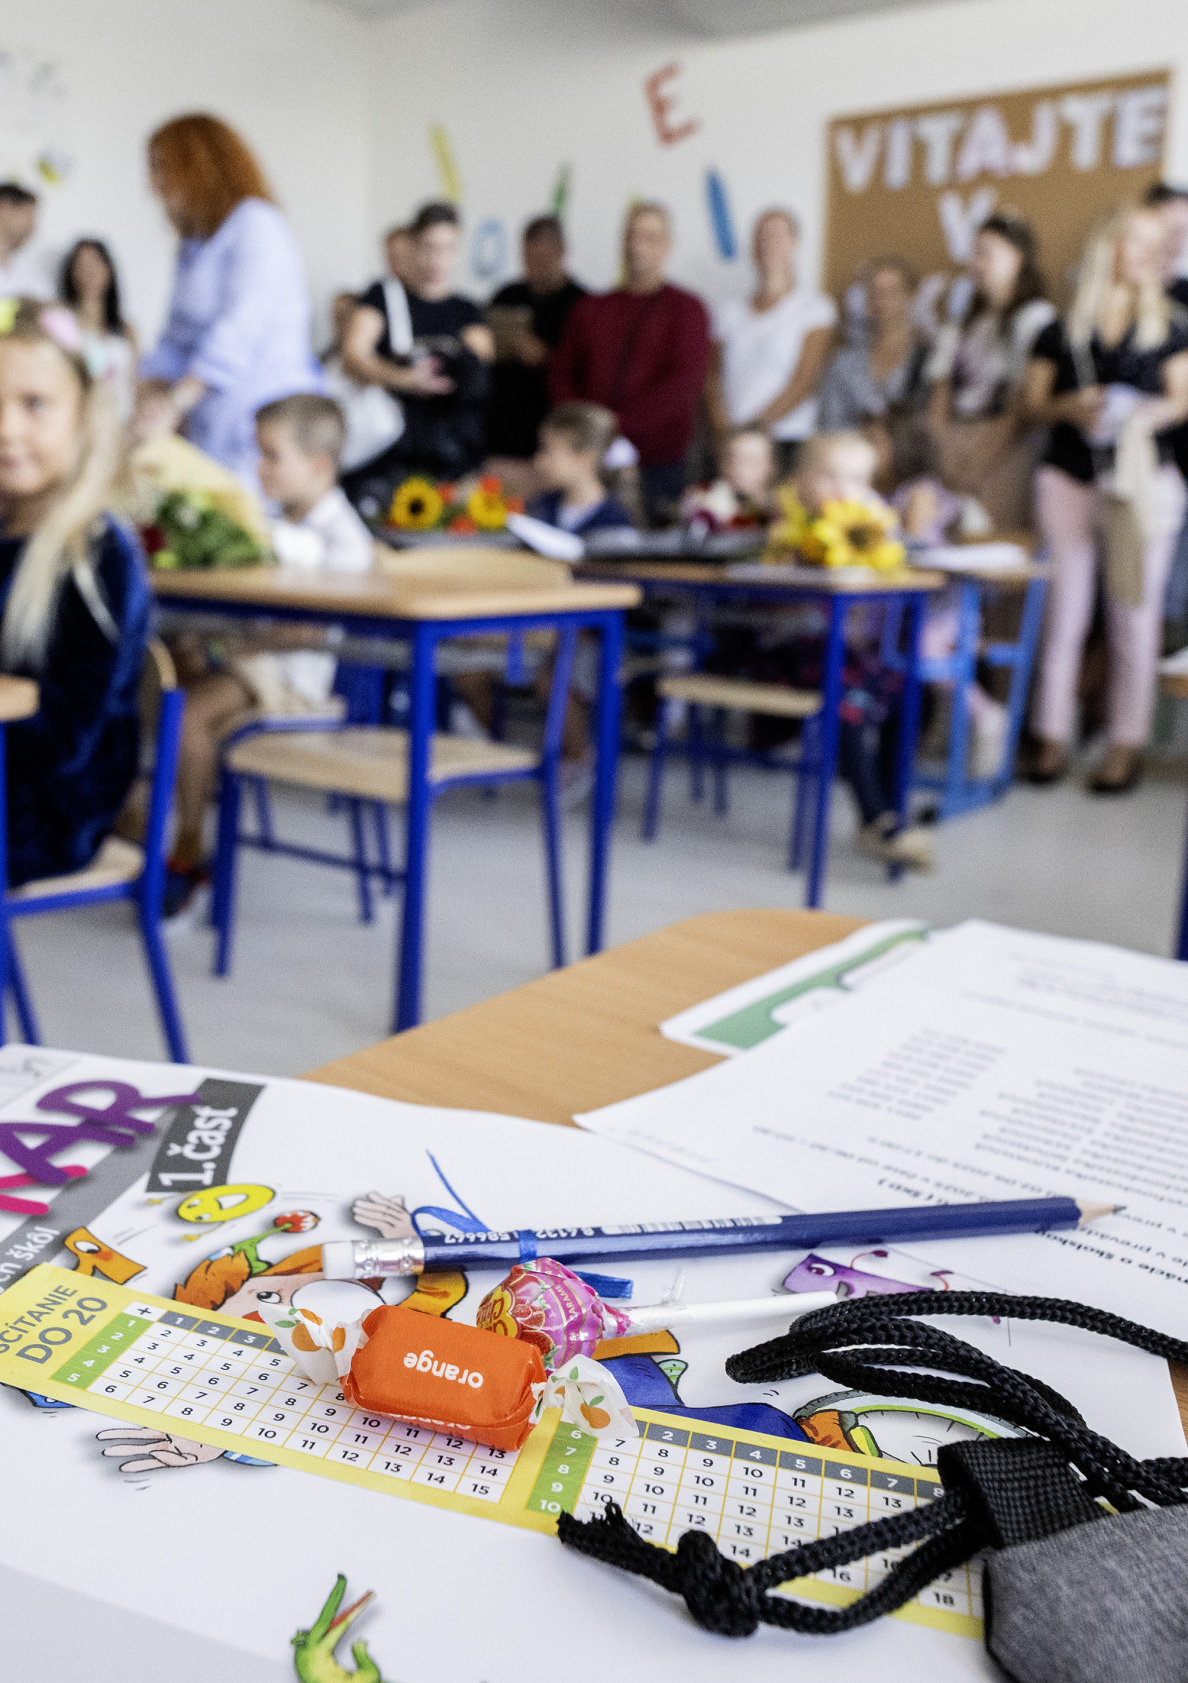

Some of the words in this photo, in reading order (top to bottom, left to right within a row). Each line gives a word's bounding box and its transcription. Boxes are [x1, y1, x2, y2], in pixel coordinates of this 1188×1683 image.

[834, 86, 1168, 191] VITAJTE
[7, 1226, 61, 1264] škôl
[15, 1327, 72, 1364] DO
[62, 1297, 108, 1326] 20
[110, 1332, 124, 1340] 2
[147, 1342, 159, 1350] 3
[183, 1353, 195, 1361] 4
[220, 1363, 232, 1371] 5
[258, 1373, 270, 1381] 6
[296, 1382, 309, 1391] 7
[127, 1320, 136, 1328] 1
[196, 1339, 208, 1347] 3
[269, 1358, 281, 1366] 5
[175, 1317, 184, 1325] 1
[207, 1327, 221, 1335] 2
[243, 1335, 257, 1344] 3
[96, 1345, 111, 1354] 3
[170, 1366, 183, 1375] 5
[208, 1377, 220, 1385] 6
[246, 1387, 259, 1395] 7
[285, 1397, 297, 1406] 8
[324, 1408, 337, 1416] 9
[362, 1417, 381, 1428] 10
[405, 1428, 420, 1438] 11
[445, 1437, 464, 1450] 12
[488, 1447, 507, 1459] 13
[403, 1350, 484, 1388] orange
[67, 1373, 81, 1382] 5
[105, 1385, 117, 1393] 6
[143, 1396, 156, 1404] 7
[181, 1407, 193, 1416] 8
[220, 1418, 233, 1427] 9
[258, 1427, 277, 1439] 10
[301, 1439, 316, 1450] 11
[341, 1450, 360, 1462] 12
[384, 1461, 403, 1473] 13
[427, 1472, 446, 1484] 14
[471, 1483, 490, 1495] 15
[82, 1359, 96, 1368] 4
[119, 1370, 132, 1378] 5
[157, 1381, 169, 1389] 6
[195, 1391, 208, 1400] 7
[233, 1402, 246, 1411] 8
[273, 1413, 285, 1422] 9
[311, 1422, 329, 1434] 10
[354, 1433, 369, 1445] 11
[394, 1444, 412, 1456] 12
[436, 1455, 455, 1466] 13
[479, 1465, 498, 1477] 14
[557, 1464, 570, 1474] 8
[603, 1474, 615, 1483] 9
[644, 1484, 664, 1495] 10
[693, 1494, 708, 1506] 11
[737, 1504, 757, 1517] 12
[785, 1515, 805, 1528] 13
[565, 1446, 577, 1456] 7
[608, 1457, 620, 1466] 8
[653, 1466, 665, 1476] 9
[694, 1475, 715, 1487] 10
[743, 1486, 758, 1497] 11
[787, 1496, 806, 1508] 12
[834, 1506, 854, 1518] 13
[570, 1430, 583, 1439] 6
[614, 1439, 626, 1447] 7
[657, 1448, 669, 1458] 8
[702, 1458, 714, 1467] 9
[743, 1466, 763, 1478] 10
[791, 1477, 806, 1488] 11
[835, 1486, 855, 1498] 12
[882, 1496, 902, 1508] 13
[661, 1431, 674, 1440] 2
[705, 1440, 718, 1449] 3
[749, 1450, 762, 1460] 4
[794, 1459, 807, 1469] 5
[840, 1469, 853, 1479] 6
[886, 1477, 899, 1488] 7
[932, 1487, 945, 1498] 8
[551, 1482, 564, 1492] 9
[592, 1492, 613, 1503] 10
[642, 1503, 657, 1515] 11
[686, 1514, 706, 1526] 12
[734, 1524, 754, 1537] 13
[782, 1535, 802, 1546] 14
[540, 1500, 561, 1513] 10
[635, 1522, 654, 1535] 12
[730, 1544, 750, 1557] 14
[932, 1592, 955, 1606] 18
